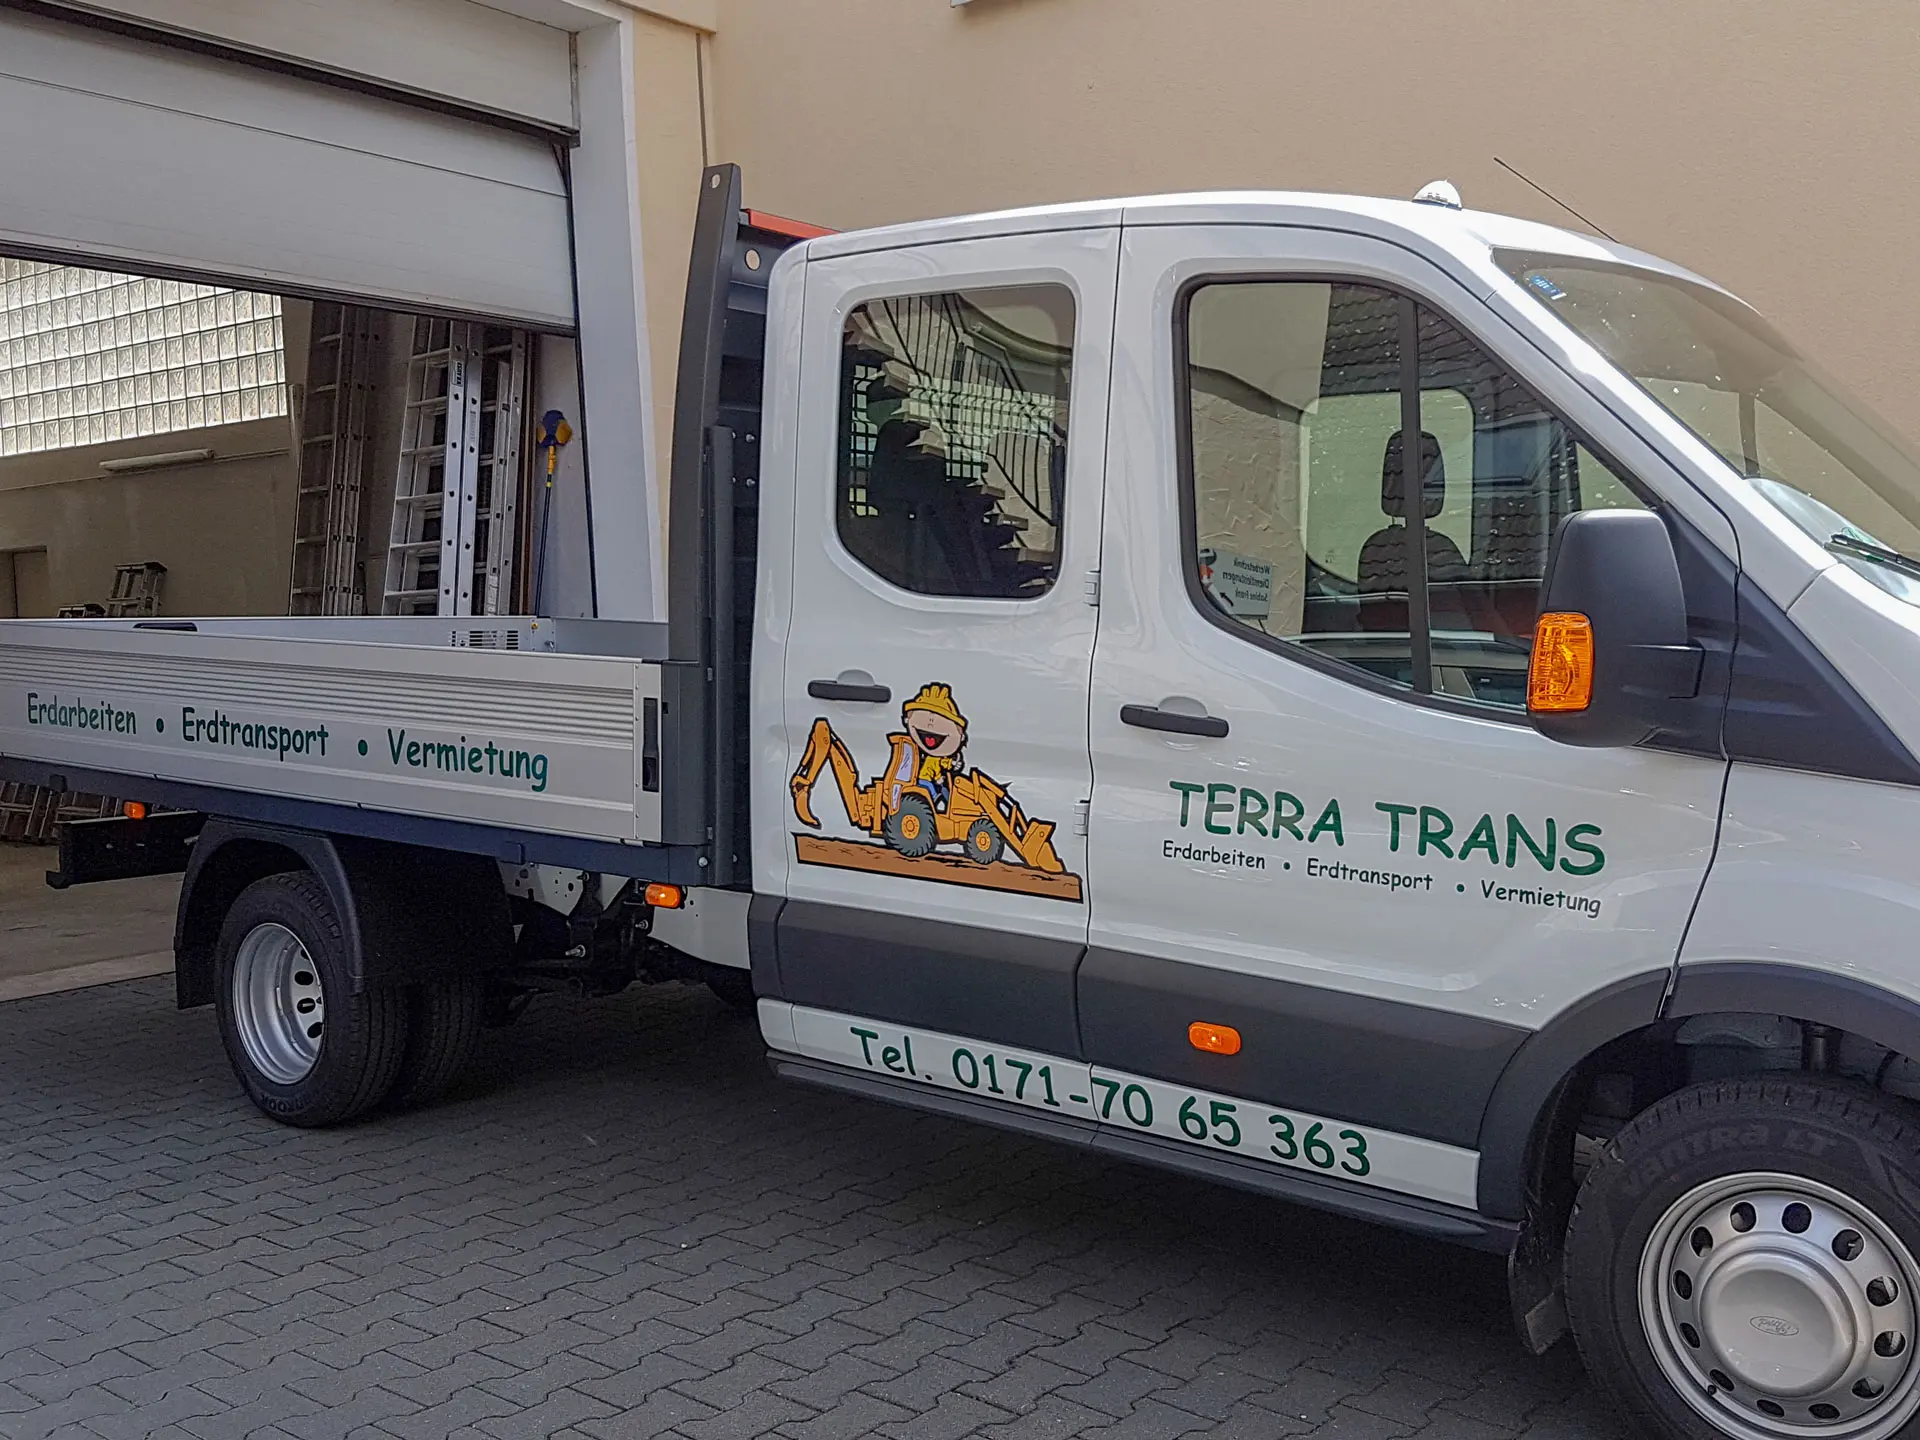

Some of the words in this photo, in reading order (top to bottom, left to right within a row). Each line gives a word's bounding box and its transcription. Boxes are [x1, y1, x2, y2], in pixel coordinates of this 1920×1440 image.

[26, 691, 137, 735] Erdarbeiten
[182, 706, 330, 763] Erdtransport
[386, 727, 548, 793] Vermietung
[1170, 781, 1344, 845] TERRA
[1376, 801, 1606, 876] TRANS
[1163, 839, 1266, 870] Erdarbeiten
[1307, 857, 1434, 893] Erdtransport
[1481, 879, 1601, 919] Vermietung
[851, 1025, 933, 1082] Tel.
[952, 1047, 1153, 1127] 0171-70
[1178, 1095, 1240, 1147] 65
[1270, 1115, 1370, 1176] 363
